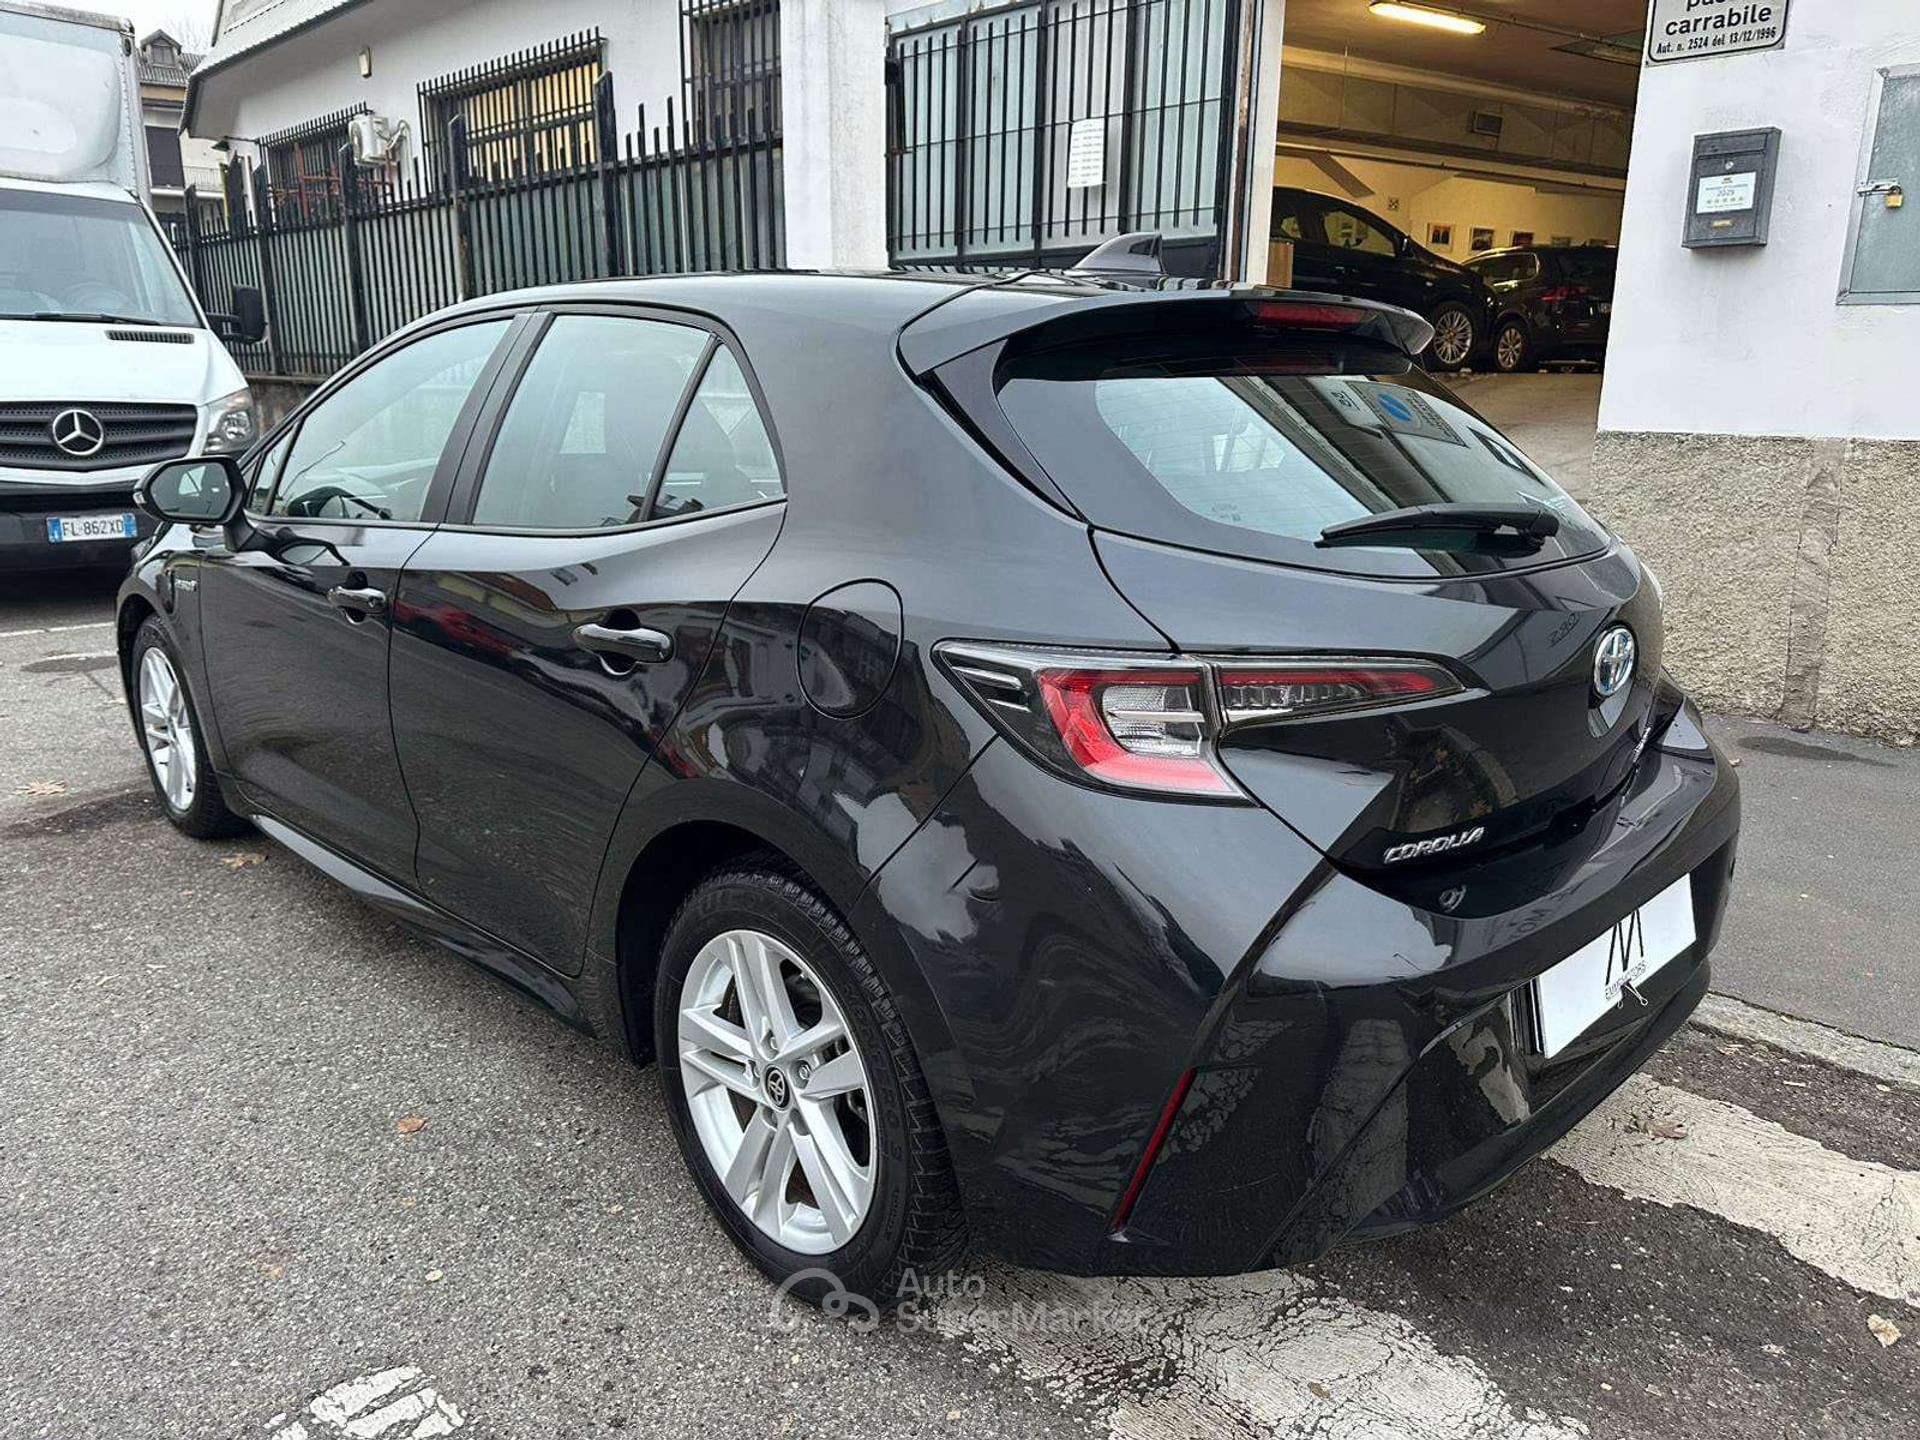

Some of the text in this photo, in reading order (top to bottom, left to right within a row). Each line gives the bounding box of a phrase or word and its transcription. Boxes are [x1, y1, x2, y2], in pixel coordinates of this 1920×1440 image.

[1665, 4, 1772, 35] carrabile
[1656, 43, 1673, 54] Aut.
[1688, 37, 1709, 49] 2524
[1712, 34, 1725, 46] del
[1383, 826, 1485, 863] COROLLA
